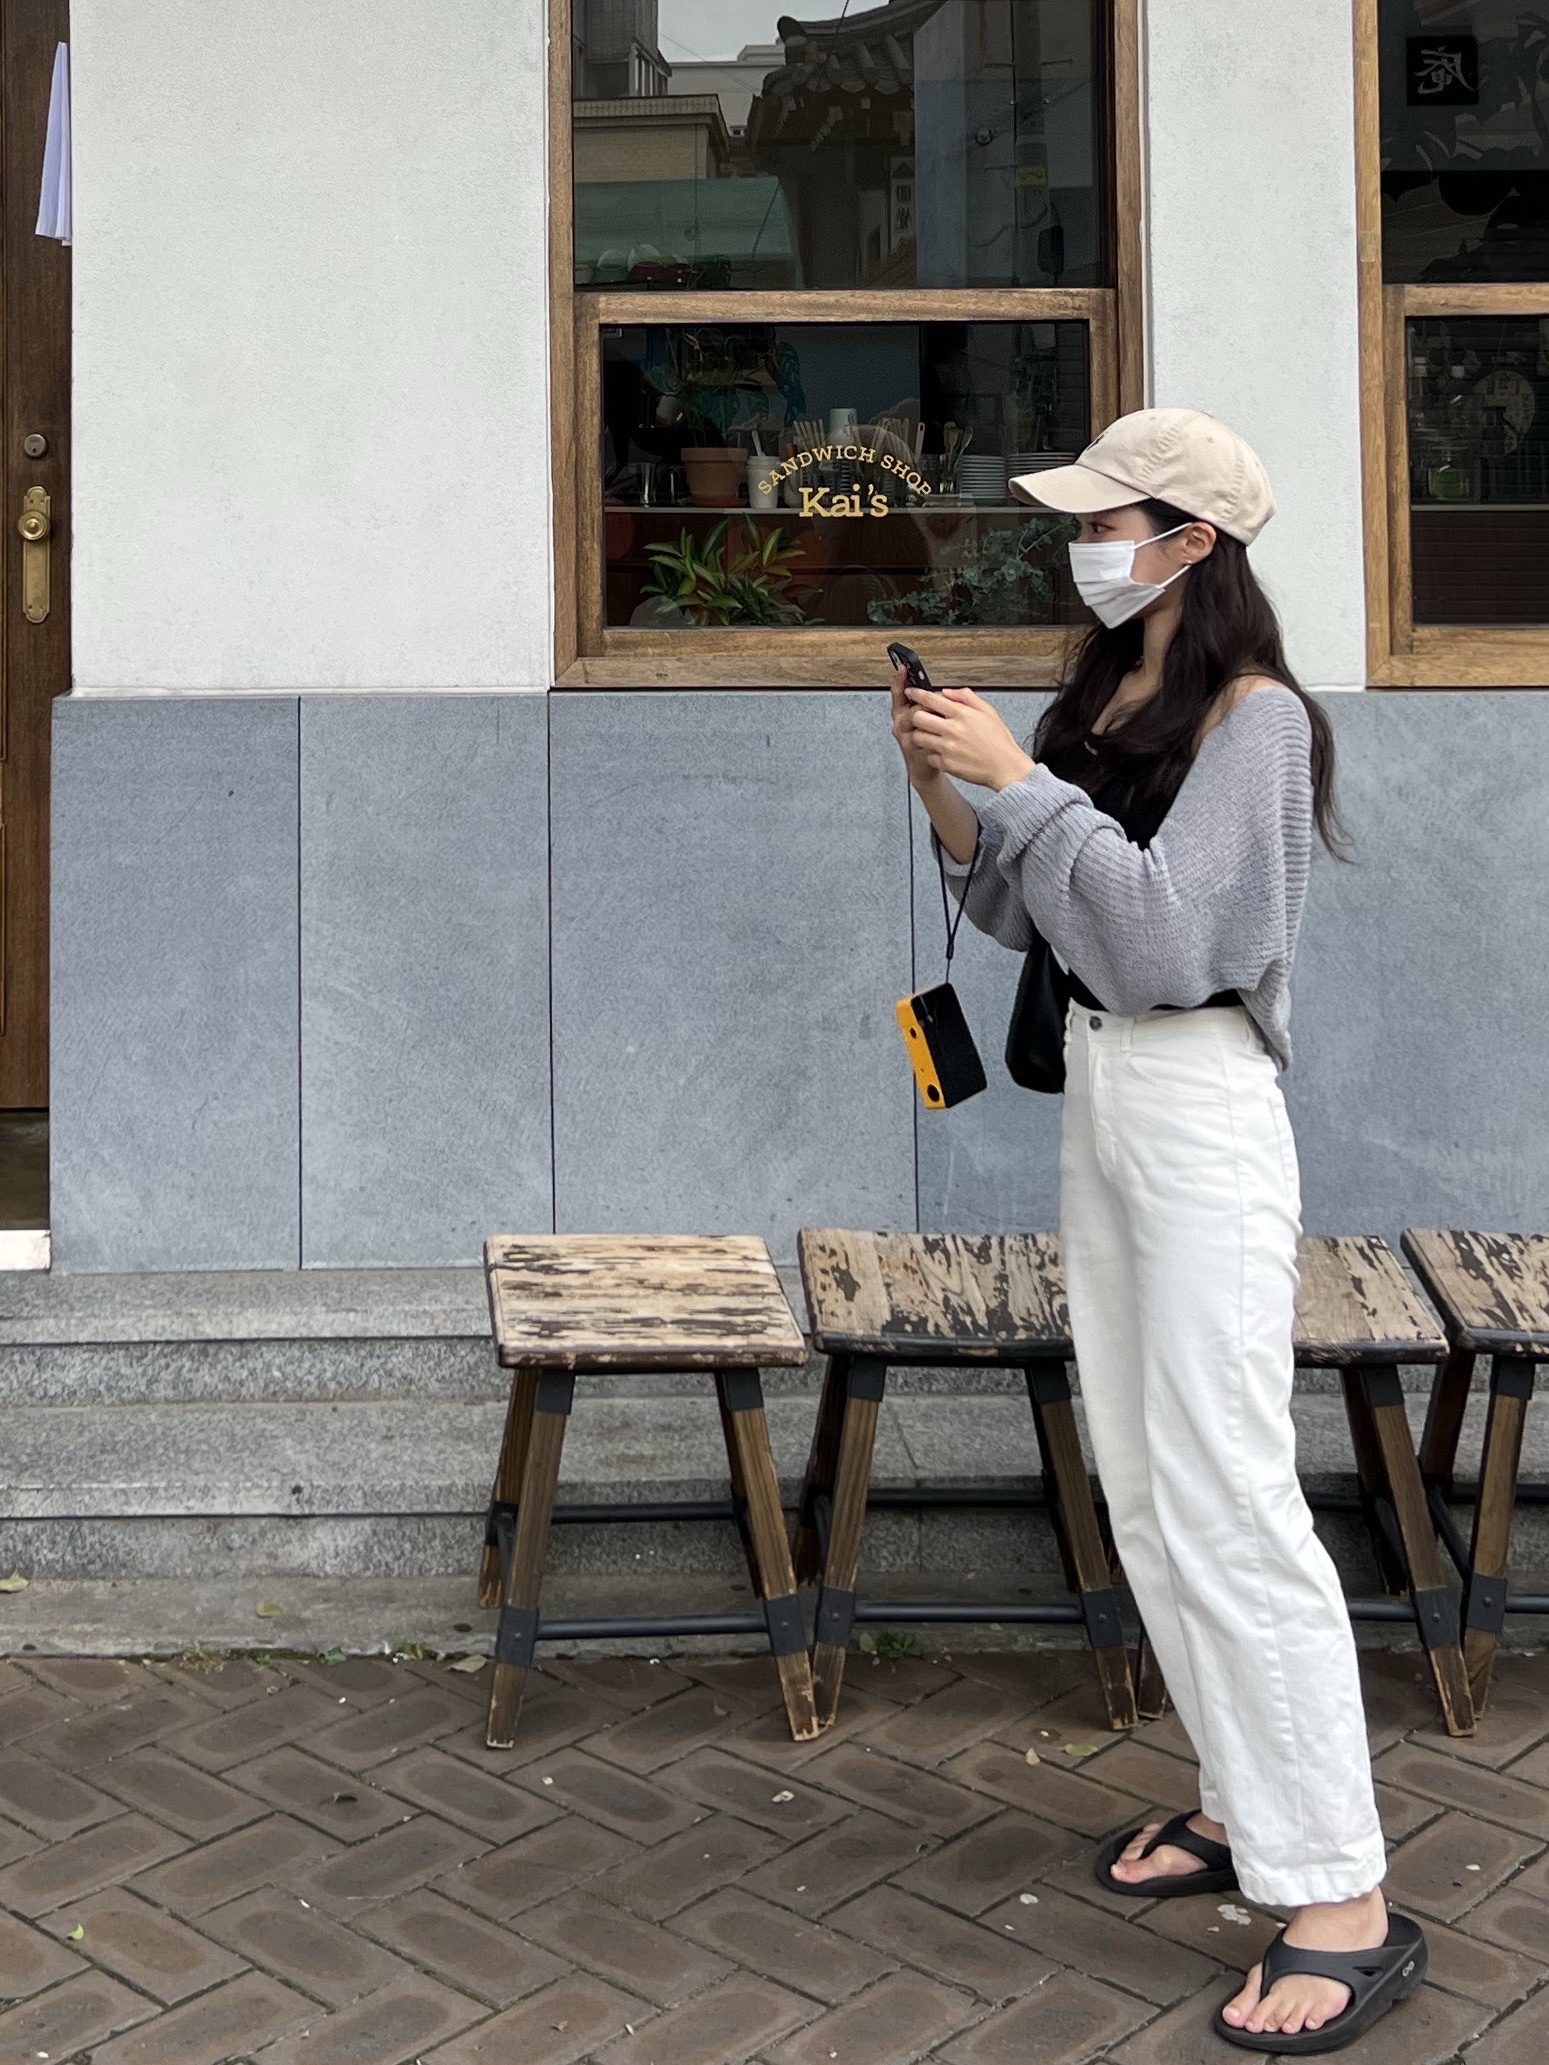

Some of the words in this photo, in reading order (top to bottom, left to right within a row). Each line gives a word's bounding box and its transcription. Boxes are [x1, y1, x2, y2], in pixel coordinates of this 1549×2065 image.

[757, 444, 876, 495] SANDWICH
[880, 454, 932, 496] SHOP
[798, 483, 889, 518] Kai's
